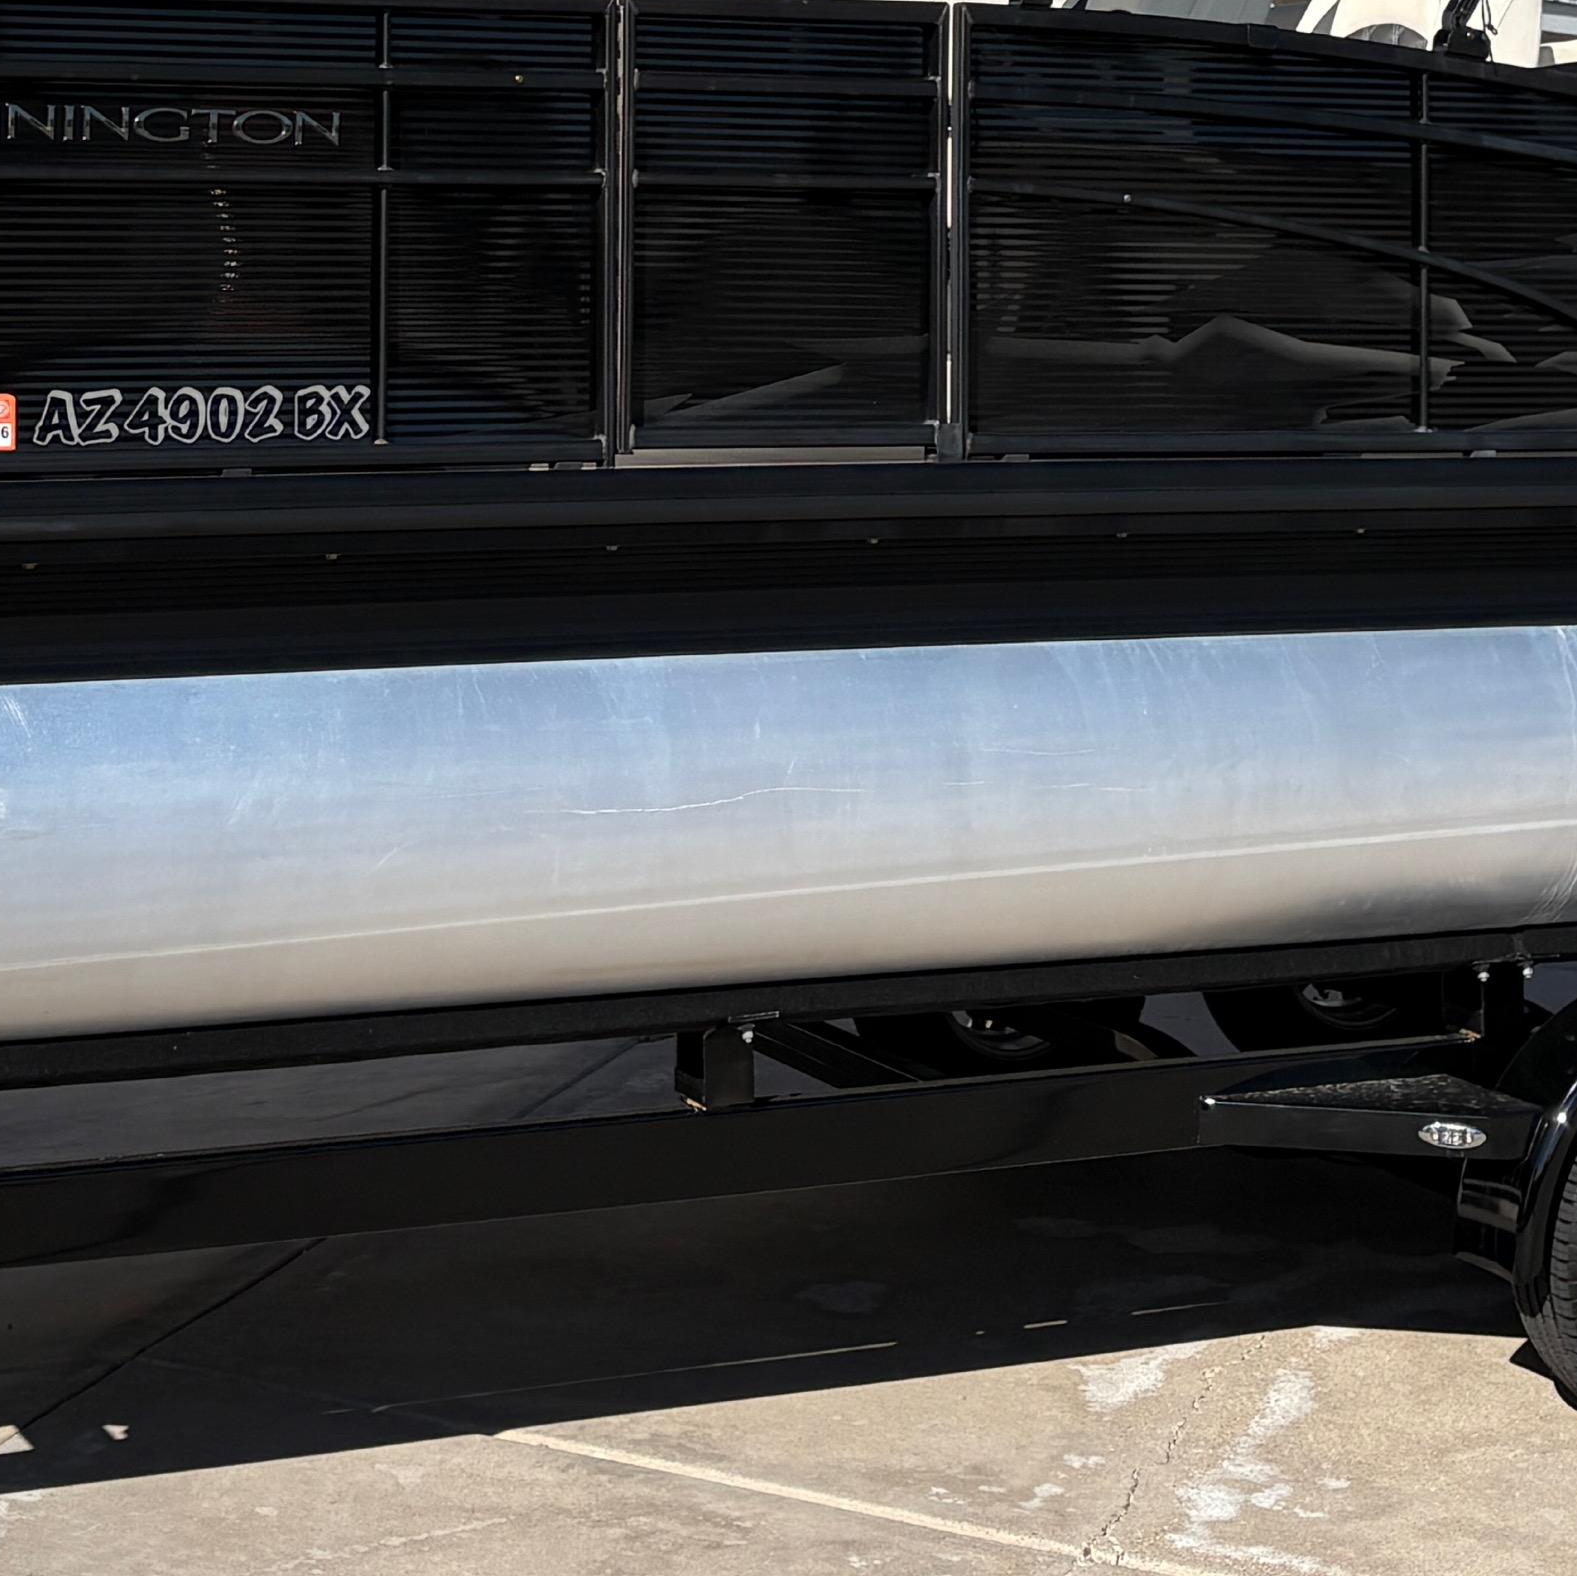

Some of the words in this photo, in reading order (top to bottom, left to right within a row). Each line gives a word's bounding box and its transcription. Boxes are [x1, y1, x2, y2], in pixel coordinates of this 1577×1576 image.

[31, 388, 122, 445] AZ
[123, 386, 283, 445] 4902
[294, 384, 372, 441] BX
